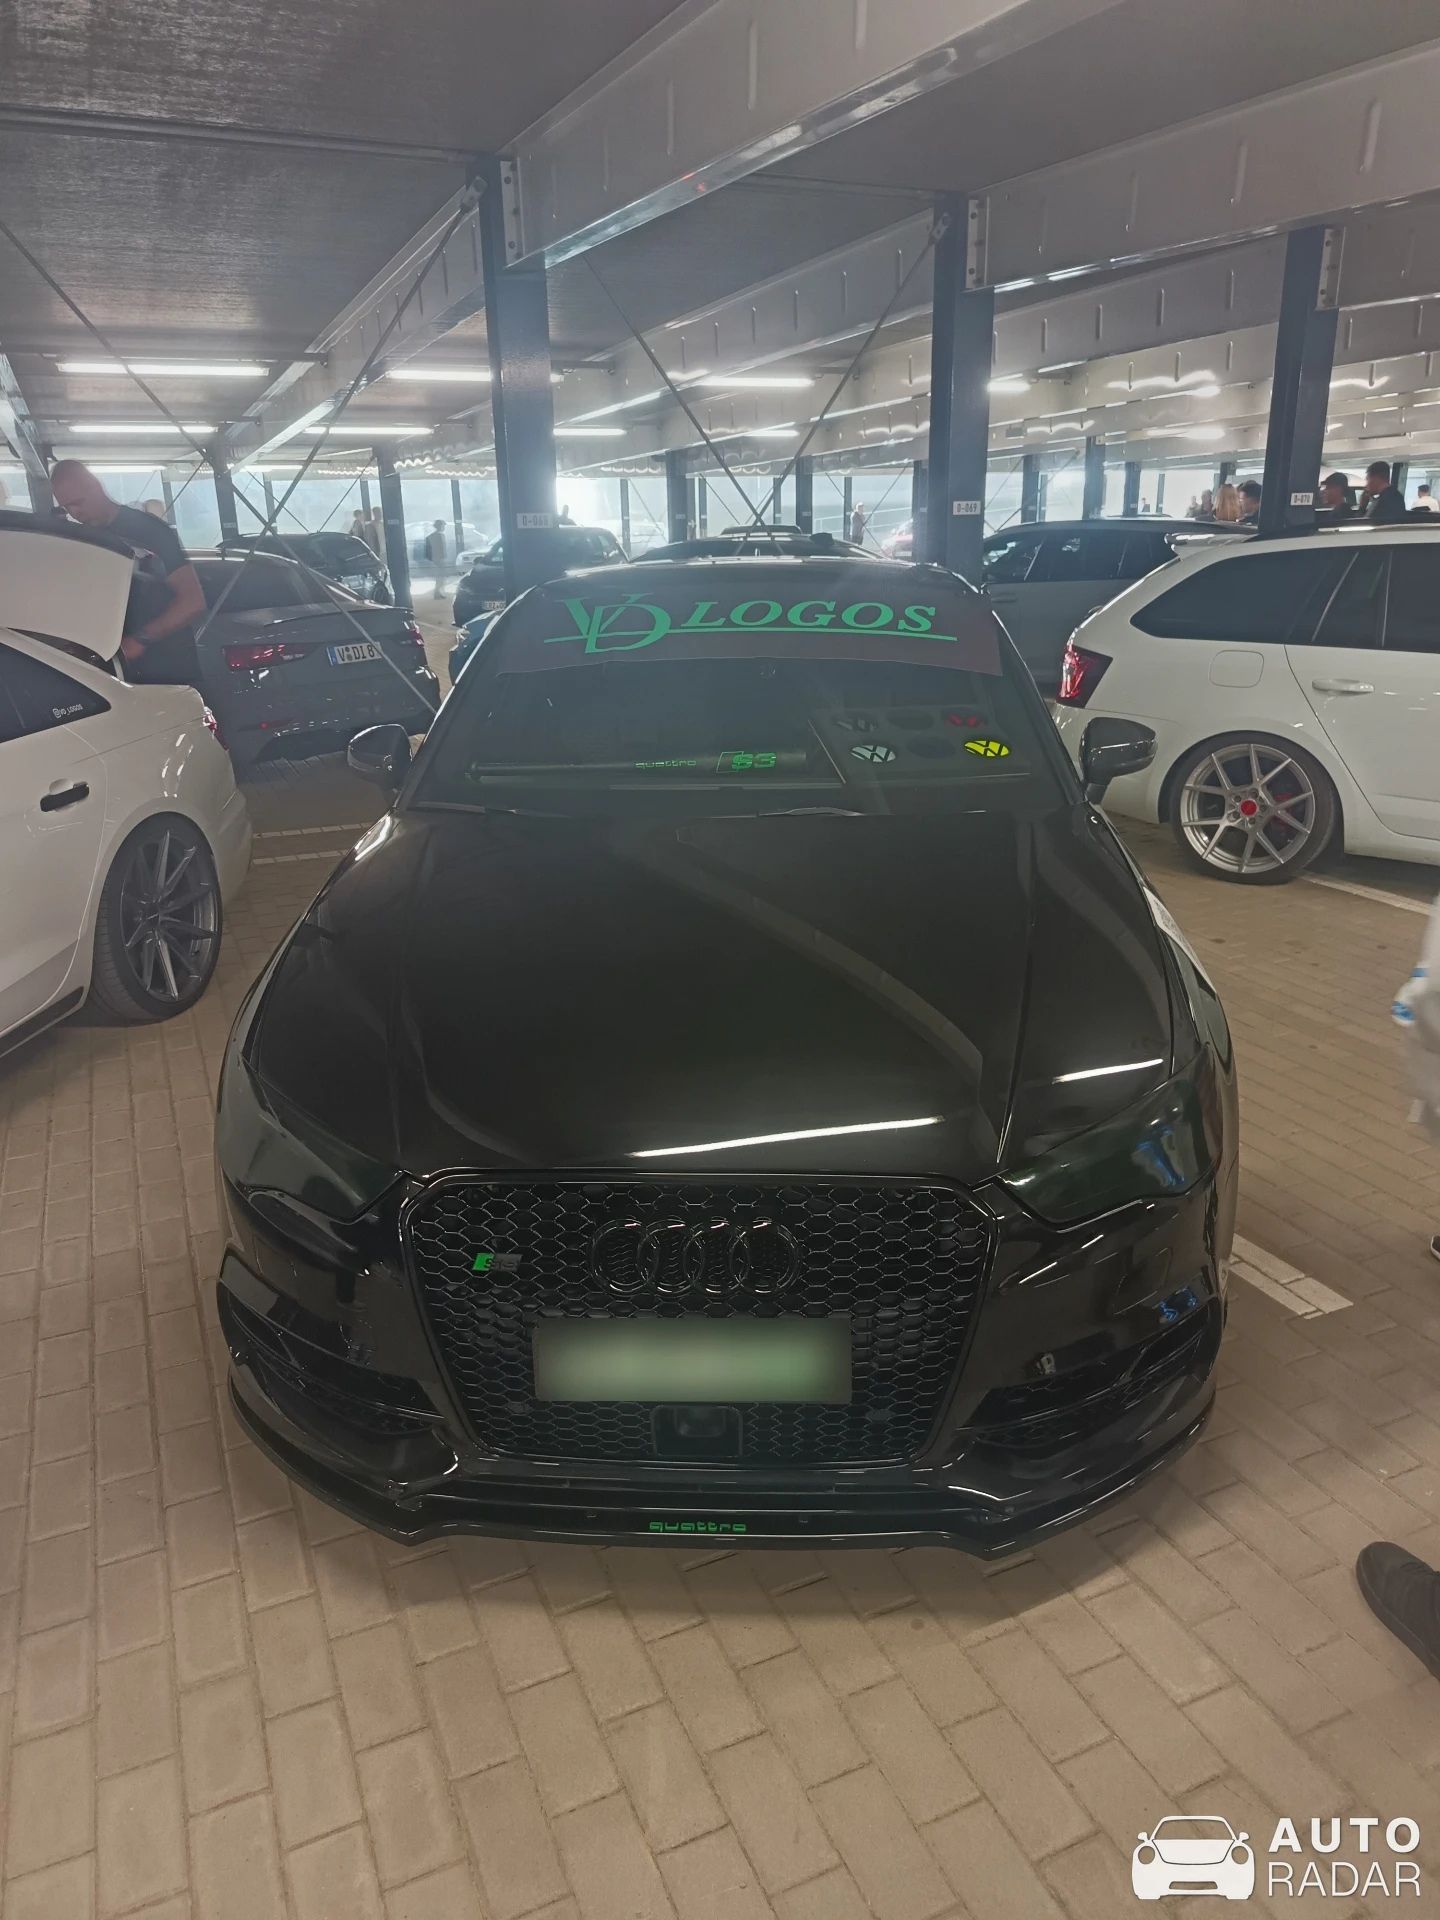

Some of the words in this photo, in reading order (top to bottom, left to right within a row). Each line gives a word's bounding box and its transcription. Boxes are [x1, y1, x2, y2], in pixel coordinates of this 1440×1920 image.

[680, 600, 937, 632] LOGOS
[337, 647, 346, 662] V
[352, 645, 367, 660] DI
[635, 760, 697, 770] quattro
[731, 752, 777, 770] S3
[649, 1521, 747, 1533] quattro
